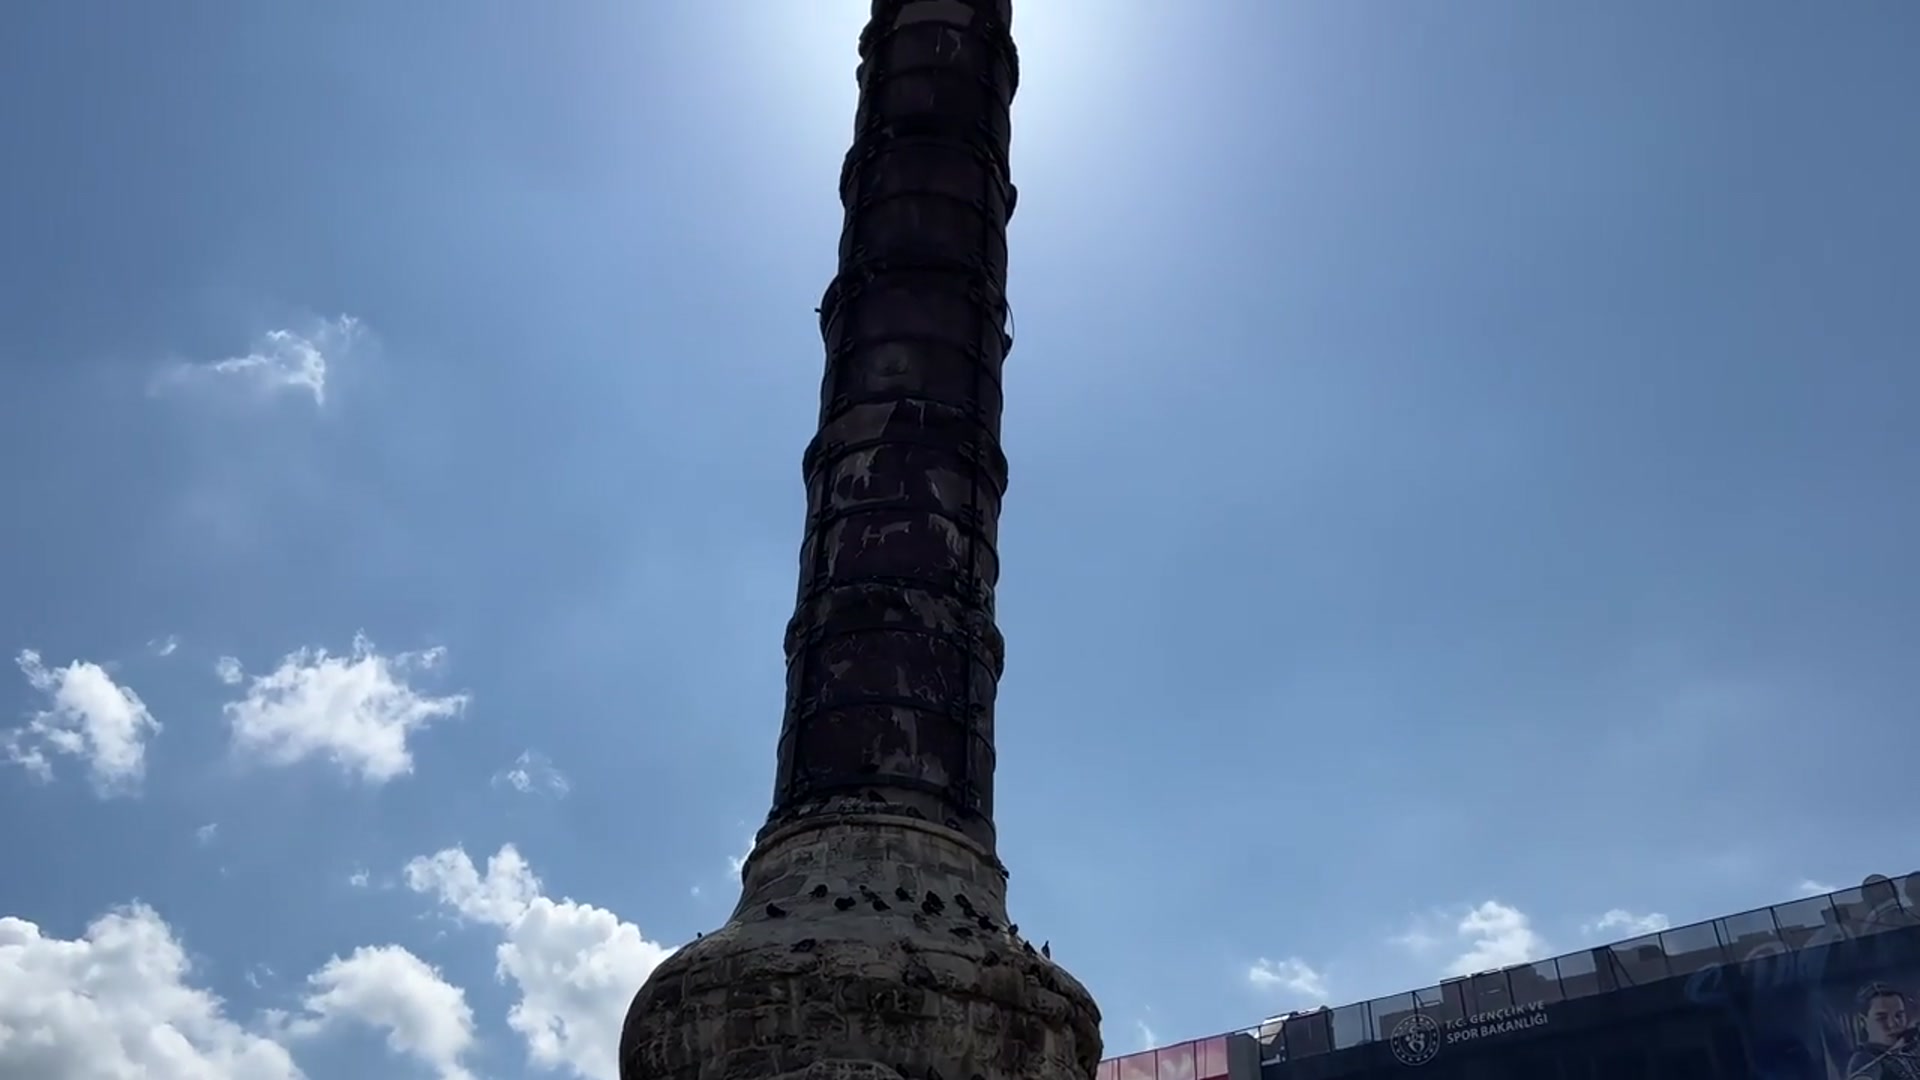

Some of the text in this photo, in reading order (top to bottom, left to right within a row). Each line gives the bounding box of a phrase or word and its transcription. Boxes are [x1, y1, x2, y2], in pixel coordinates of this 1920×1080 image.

[1445, 1017, 1467, 1030] T.C.
[1527, 1000, 1545, 1011] VE
[1446, 1012, 1549, 1044] SPOR BAKANLIĞI
